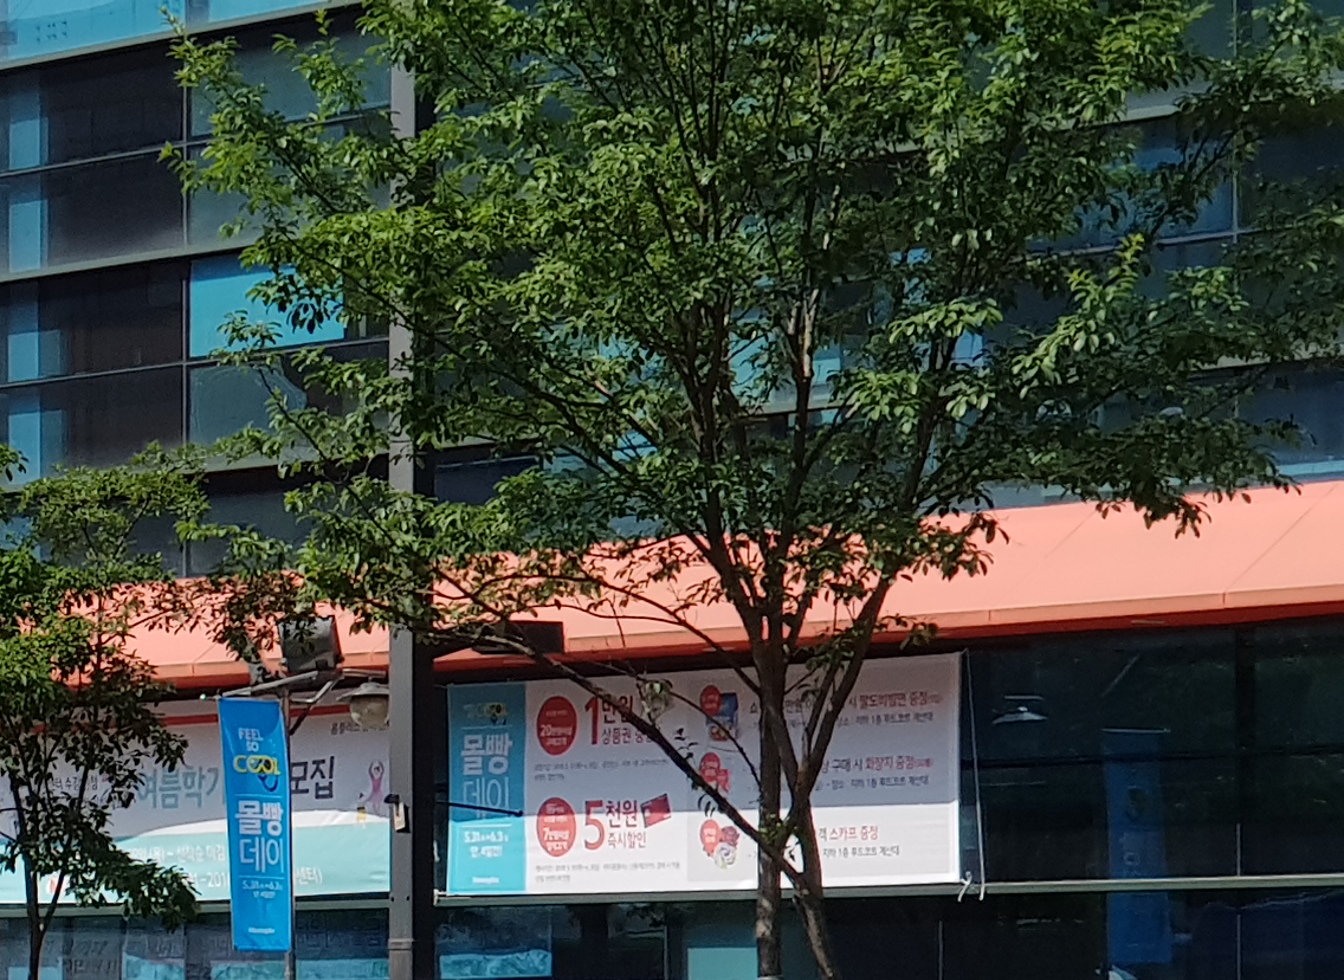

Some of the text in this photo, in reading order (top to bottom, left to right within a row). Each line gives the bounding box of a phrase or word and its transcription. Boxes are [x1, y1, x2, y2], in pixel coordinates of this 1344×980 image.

[238, 727, 264, 741] FEEL
[601, 728, 632, 745] 상품권
[245, 740, 260, 752] SO
[461, 733, 513, 776] 몰빵
[232, 754, 281, 776] COOL
[865, 755, 893, 771] 화장지
[289, 755, 336, 801] 모집
[462, 776, 510, 819] 데이
[234, 800, 284, 837] 몰빵
[607, 831, 647, 849] 즉시할인
[829, 827, 858, 841] 스카프
[860, 825, 879, 841] 증정
[238, 837, 285, 873] 데이
